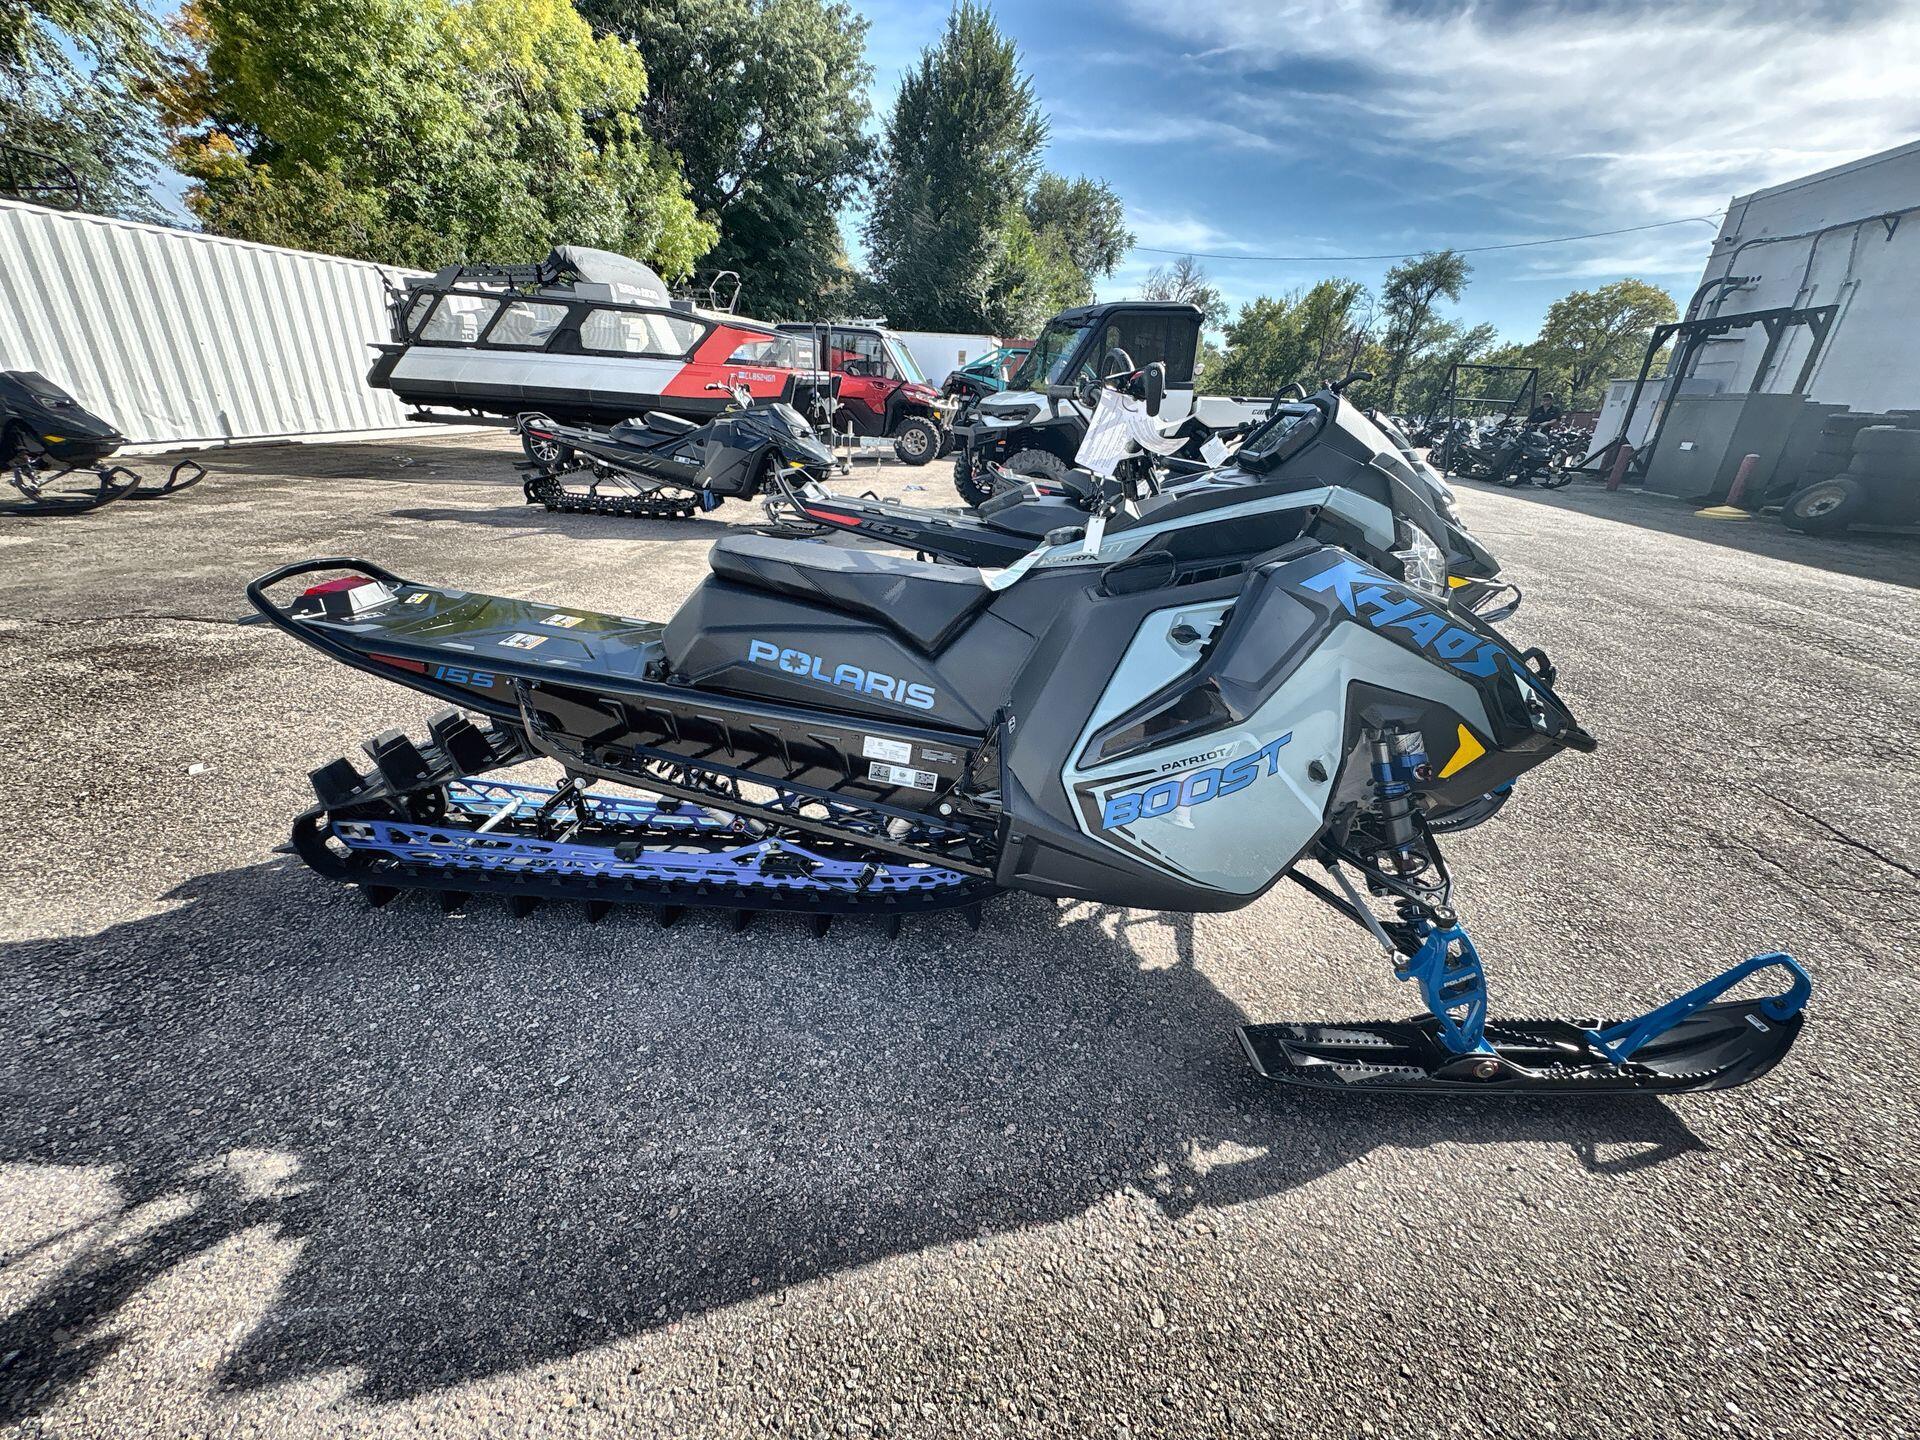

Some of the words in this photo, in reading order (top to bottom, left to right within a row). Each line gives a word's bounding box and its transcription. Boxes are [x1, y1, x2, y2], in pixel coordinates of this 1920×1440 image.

[1299, 558, 1506, 678] KHAOS
[433, 665, 496, 689] 155
[748, 639, 936, 710] POLARIS
[1102, 731, 1293, 830] BOOST
[1161, 747, 1226, 772] PATRIOT
